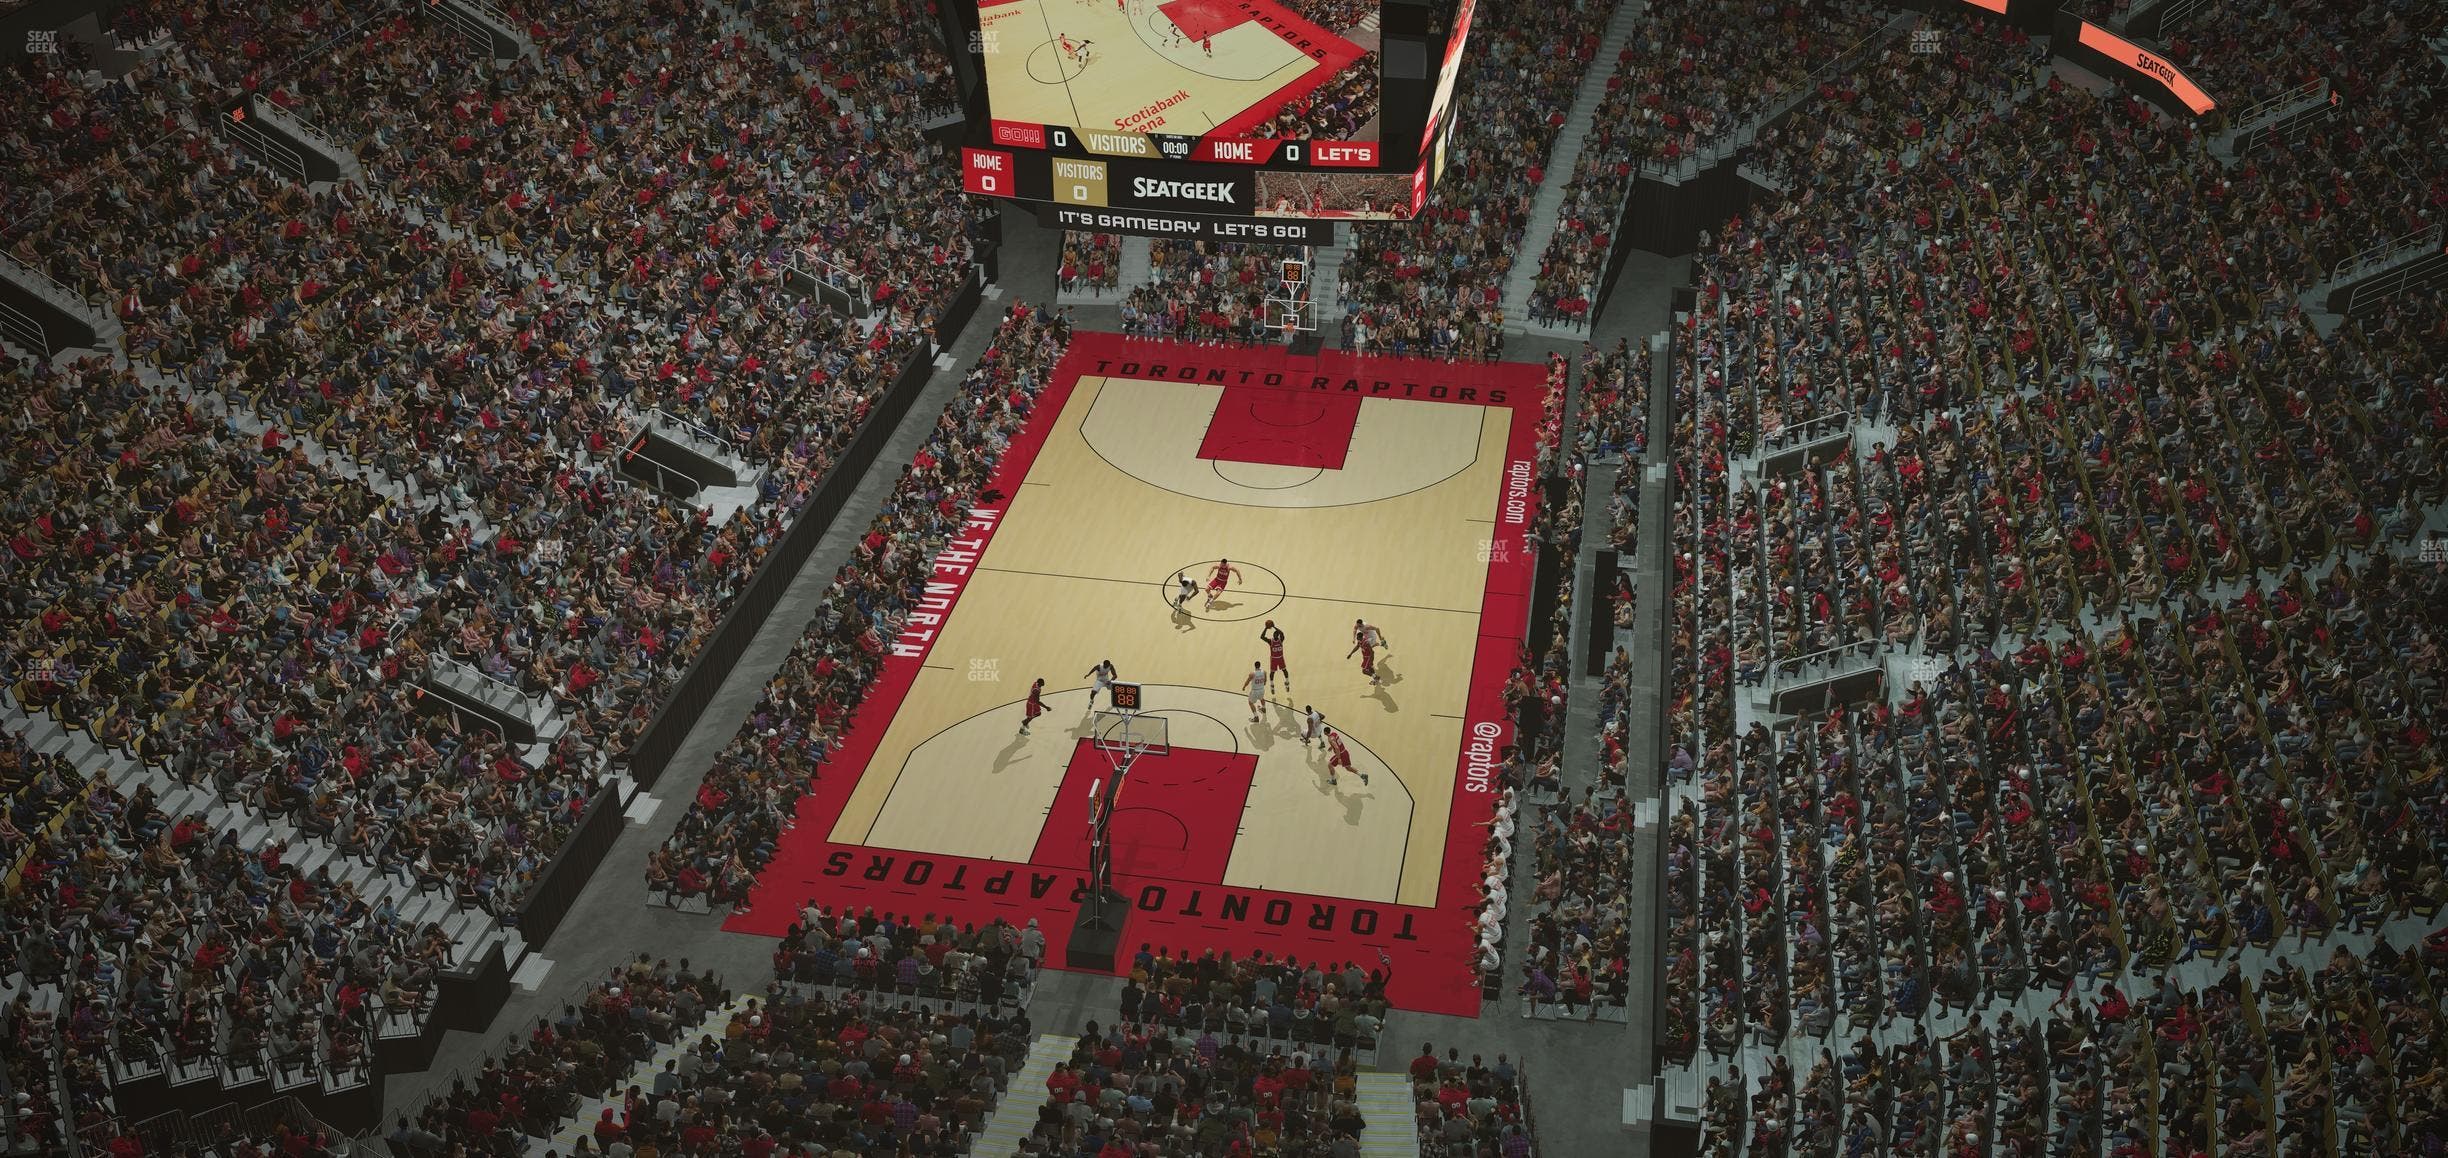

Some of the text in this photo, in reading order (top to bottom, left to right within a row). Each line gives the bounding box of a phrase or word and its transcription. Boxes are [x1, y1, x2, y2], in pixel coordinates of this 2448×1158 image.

[1239, 2, 1327, 58] RAPTORS
[2136, 53, 2176, 87] SEATGEEK
[1114, 88, 1190, 131] Scotiabank
[999, 127, 1040, 143] GO!!!
[1132, 115, 1166, 134] rena
[1054, 131, 1067, 147] 0
[1089, 133, 1146, 154] VISITORS
[1163, 141, 1188, 155] 00:00
[1214, 141, 1253, 160] HOME
[1286, 145, 1299, 161] 0
[1318, 147, 1371, 161] LET'S
[973, 153, 1002, 171] HOME
[1056, 162, 1103, 181] VISITORS
[981, 175, 996, 191] 0
[1073, 185, 1088, 201] 0
[1133, 176, 1236, 204] SEATGEEK
[1059, 210, 1306, 238] IT'S GAMEDAY LET'S GO!
[1097, 360, 1508, 403] TORONTO RAPTORS
[1505, 460, 1531, 524] raptors.com
[933, 538, 984, 576] THE
[892, 582, 959, 658] NORTH
[1464, 721, 1502, 793] @raptors
[1137, 884, 1418, 941] TORONTO
